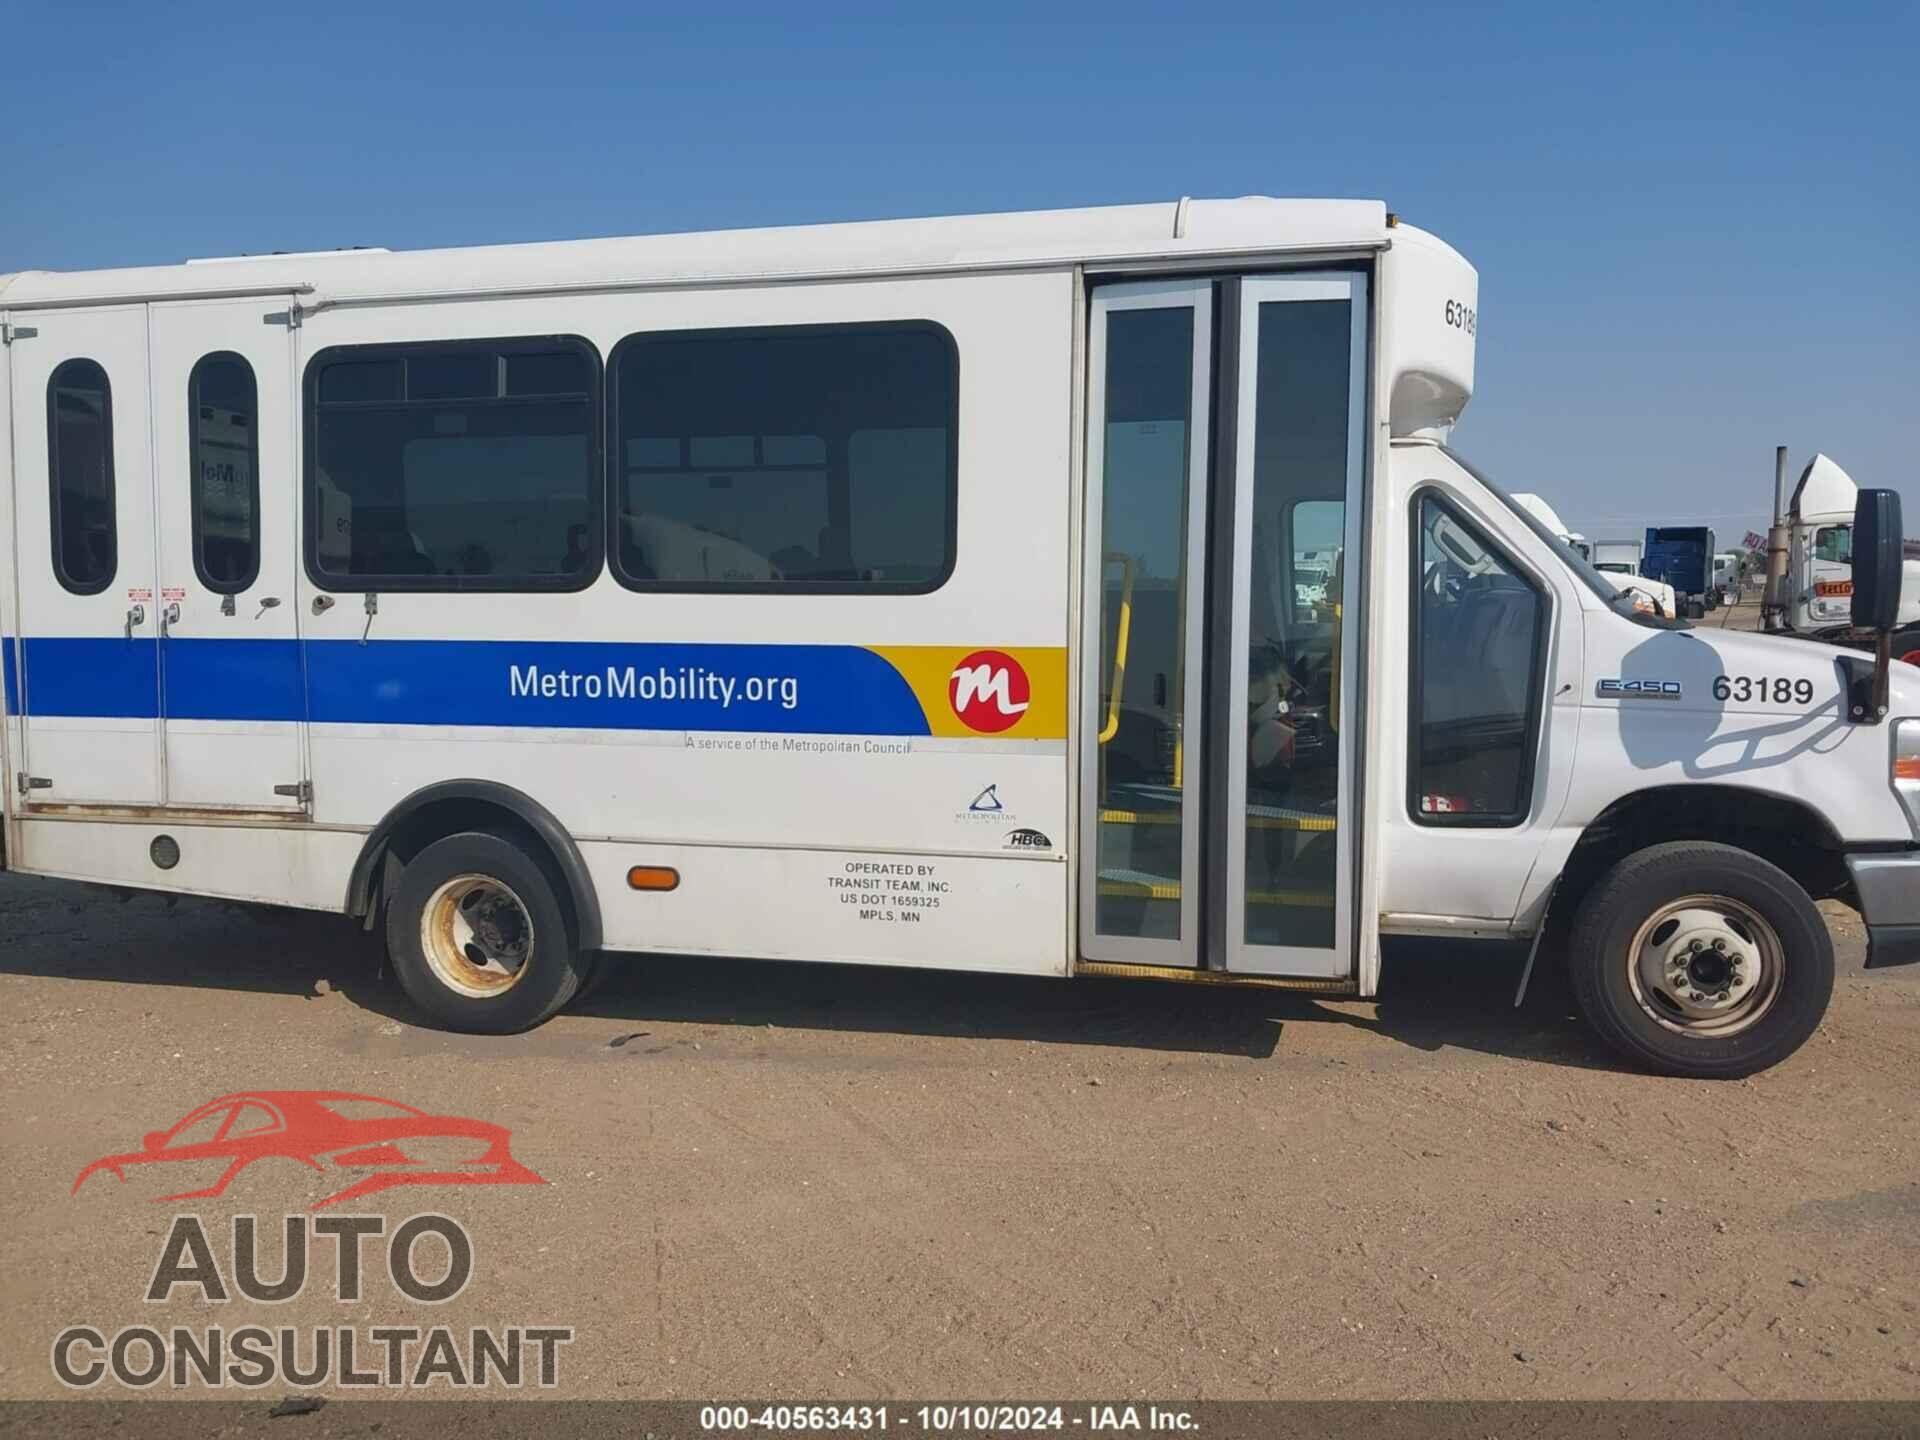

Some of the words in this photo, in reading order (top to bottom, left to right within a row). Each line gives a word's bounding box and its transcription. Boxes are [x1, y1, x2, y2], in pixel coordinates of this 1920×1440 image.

[510, 665, 798, 709] MetroMobility.org
[1712, 675, 1814, 704] 63189
[686, 736, 695, 748] A
[699, 738, 742, 750] service
[744, 738, 757, 751] of
[759, 739, 779, 751] the
[782, 738, 860, 754] Metropolitan
[864, 740, 911, 754] Council
[1011, 834, 1044, 846] HBC
[845, 862, 914, 876] OPERATED
[917, 865, 935, 876] BY
[828, 877, 881, 889] TRANSIT
[886, 879, 924, 892] TEAM,
[927, 881, 953, 893] INC.
[840, 894, 857, 904] US
[861, 894, 887, 905] DOT
[892, 895, 941, 908] 1659325
[859, 909, 897, 921] MPLS,
[901, 911, 920, 922] MN
